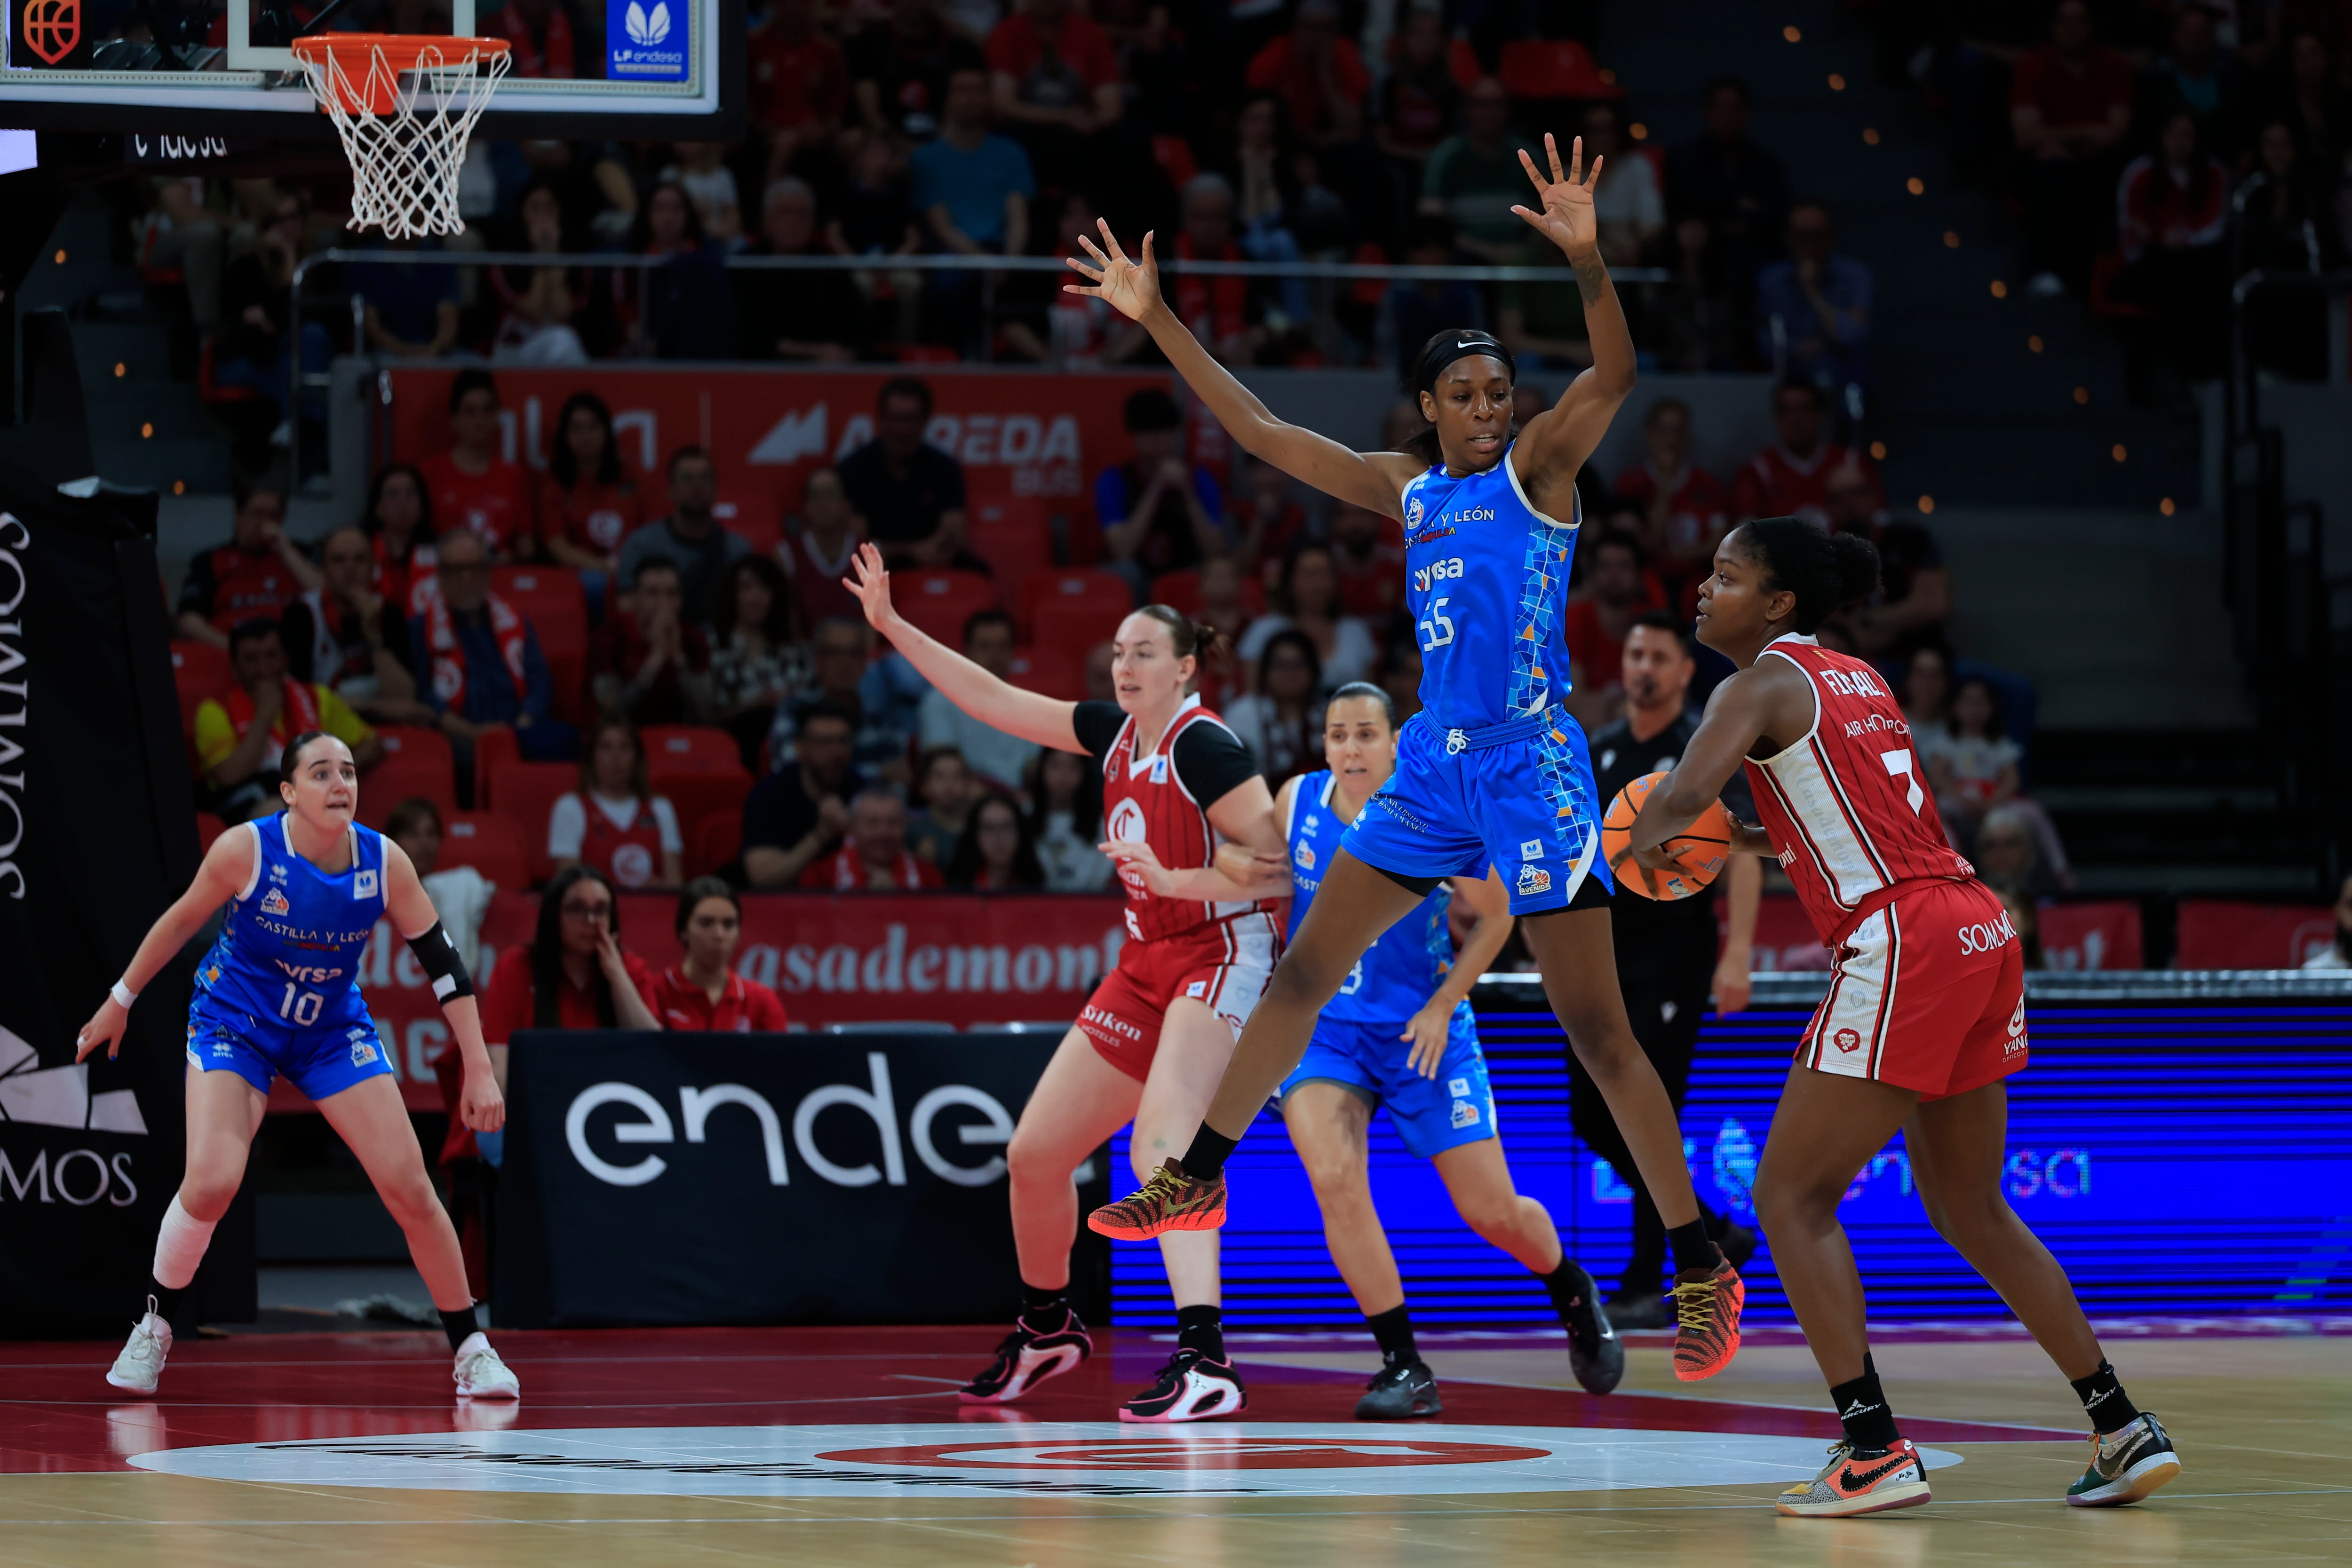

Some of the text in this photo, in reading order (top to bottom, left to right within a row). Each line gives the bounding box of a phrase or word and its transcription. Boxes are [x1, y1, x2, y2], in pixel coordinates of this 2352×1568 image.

[614, 49, 683, 63] LF endesa
[834, 415, 1079, 464] AREDA
[1454, 505, 1495, 523] LEÓN
[1844, 720, 1865, 738] AIR
[1880, 748, 1924, 819] 7
[1521, 883, 1549, 894] AVENIDA
[255, 915, 318, 940] CASTILLA
[326, 931, 335, 943] Y
[280, 981, 324, 1027] 10
[1080, 1004, 1142, 1041] Silken
[565, 1053, 1017, 1187] ende
